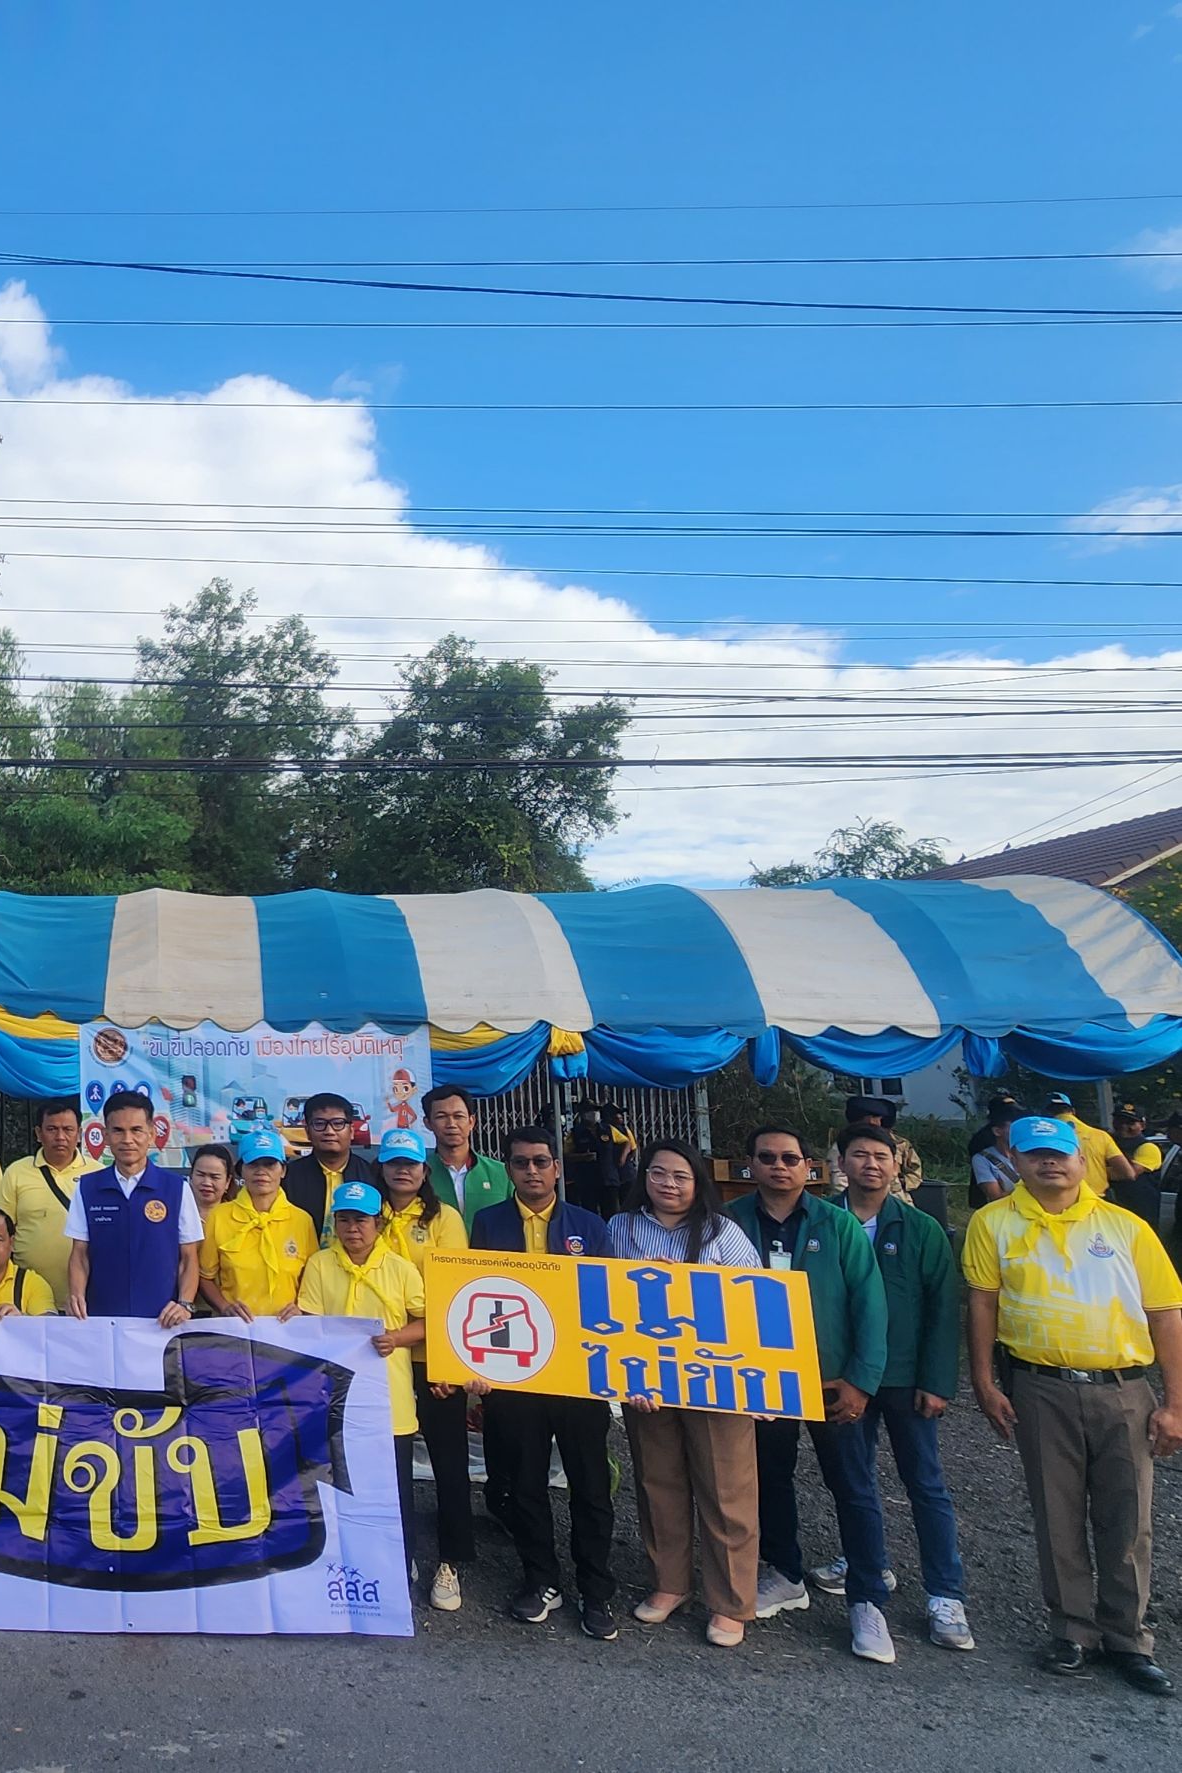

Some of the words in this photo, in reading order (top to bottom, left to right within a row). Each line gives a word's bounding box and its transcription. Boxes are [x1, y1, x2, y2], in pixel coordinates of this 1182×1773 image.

[90, 1131, 101, 1141] 50
[576, 1262, 794, 1350] เมา
[581, 1341, 803, 1418] ไม่ขับ
